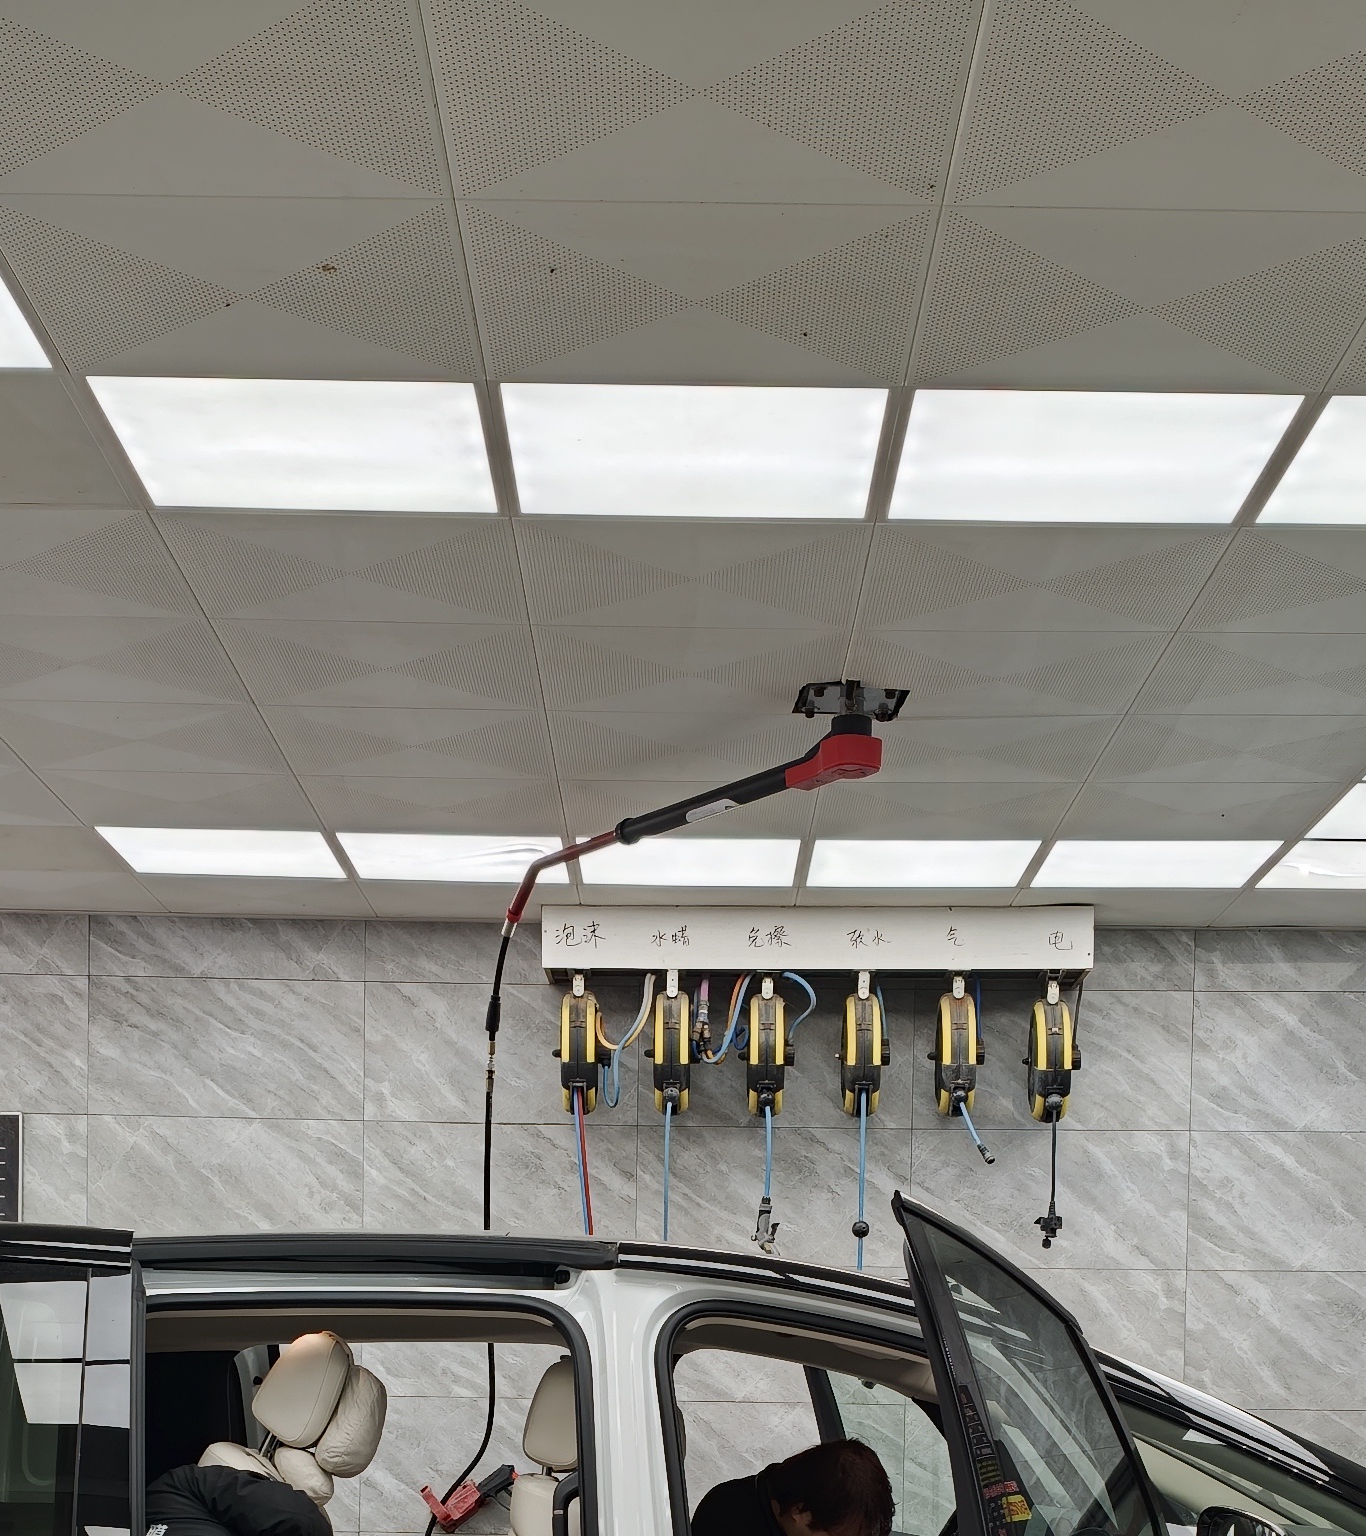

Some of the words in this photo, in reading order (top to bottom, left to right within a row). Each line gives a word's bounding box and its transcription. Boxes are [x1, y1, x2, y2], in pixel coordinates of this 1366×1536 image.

[555, 920, 606, 948] 泡沫
[651, 925, 690, 948] 水蜡
[946, 925, 966, 947] 气
[1049, 930, 1073, 951] 电
